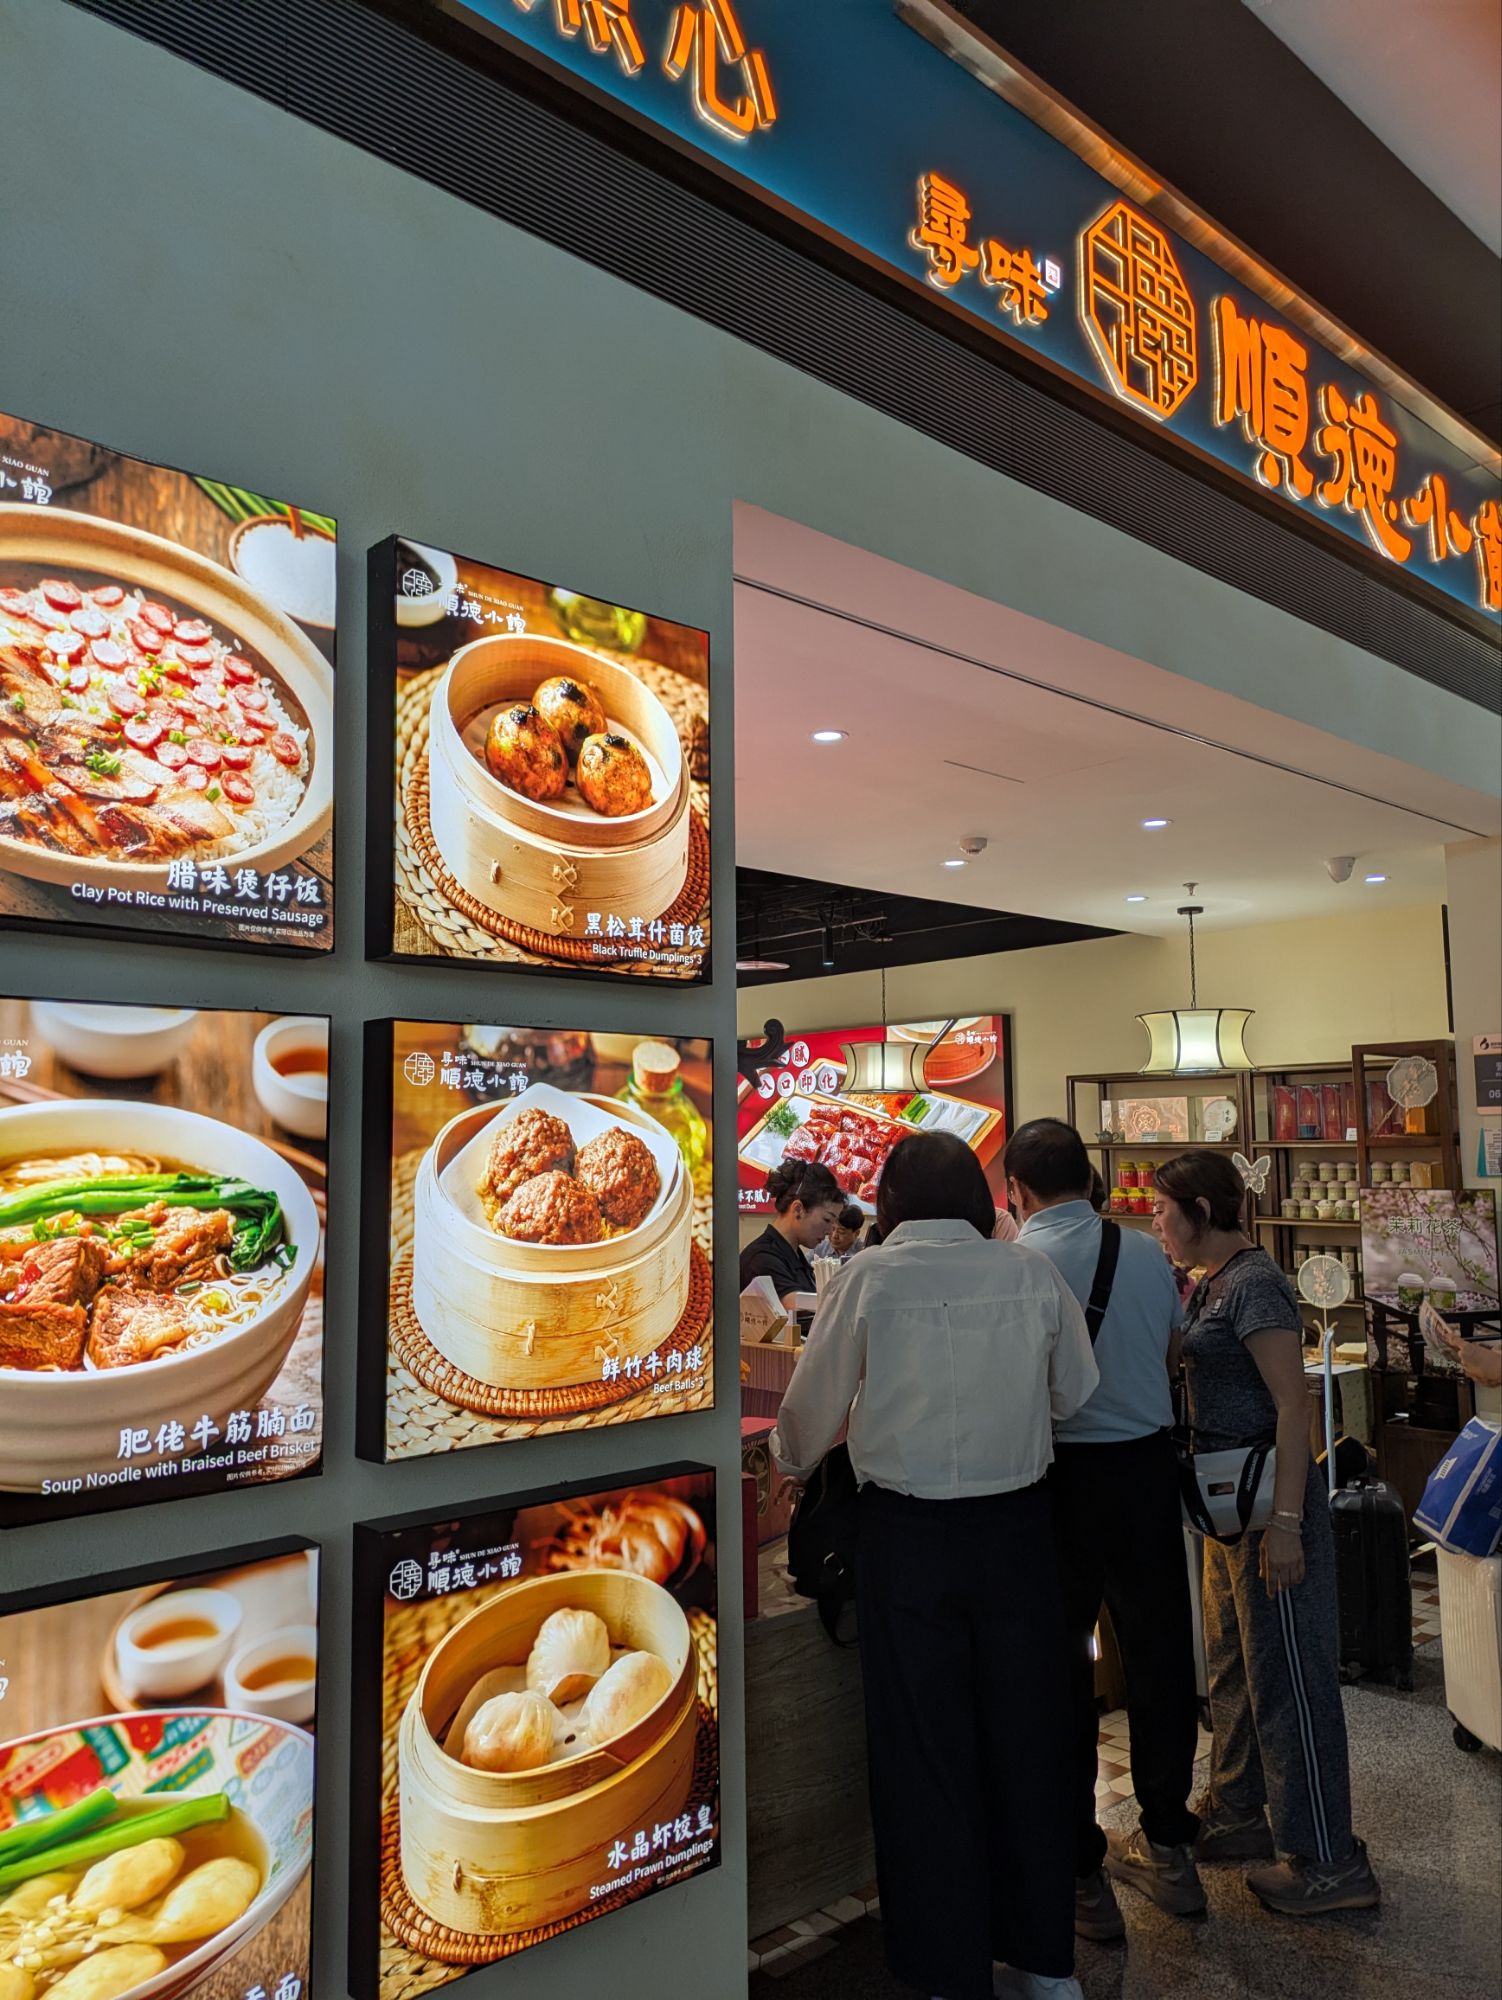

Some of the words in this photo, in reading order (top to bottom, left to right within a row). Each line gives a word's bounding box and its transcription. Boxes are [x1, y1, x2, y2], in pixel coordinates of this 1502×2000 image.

[2, 456, 24, 468] XIAO
[25, 464, 50, 477] GUAN
[167, 860, 322, 904] 腊味煲仔饭
[71, 882, 103, 902] Clay
[107, 887, 132, 903] Pot
[136, 892, 166, 907] Rice
[168, 894, 199, 911] with
[202, 900, 268, 920] Preserved
[271, 907, 324, 927] Sausage
[584, 912, 706, 948] 黑松茸什菌饺
[592, 944, 617, 956] Black
[619, 946, 648, 959] Truffle
[760, 1074, 835, 1092] 入口即化
[1388, 1216, 1463, 1235] 茉莉花茶
[602, 1345, 704, 1382] 鲜竹牛肉球
[653, 1383, 673, 1394] Beef
[116, 1402, 315, 1460] 肥佬牛筋腩面
[41, 1478, 83, 1495] Soup
[86, 1467, 142, 1489] Noodle
[145, 1460, 178, 1479] with
[181, 1451, 234, 1472] Braised
[237, 1446, 267, 1464] Beef
[270, 1438, 316, 1458] Brisket
[460, 1551, 476, 1560] SHUN
[477, 1549, 486, 1557] DE
[487, 1546, 502, 1556] XIAO
[502, 1543, 519, 1552] GUAN
[607, 1804, 713, 1869] 水晶虾饺皇
[590, 1871, 633, 1900] Steamed
[634, 1861, 664, 1881] Prawn
[665, 1838, 713, 1868] Dumplings
